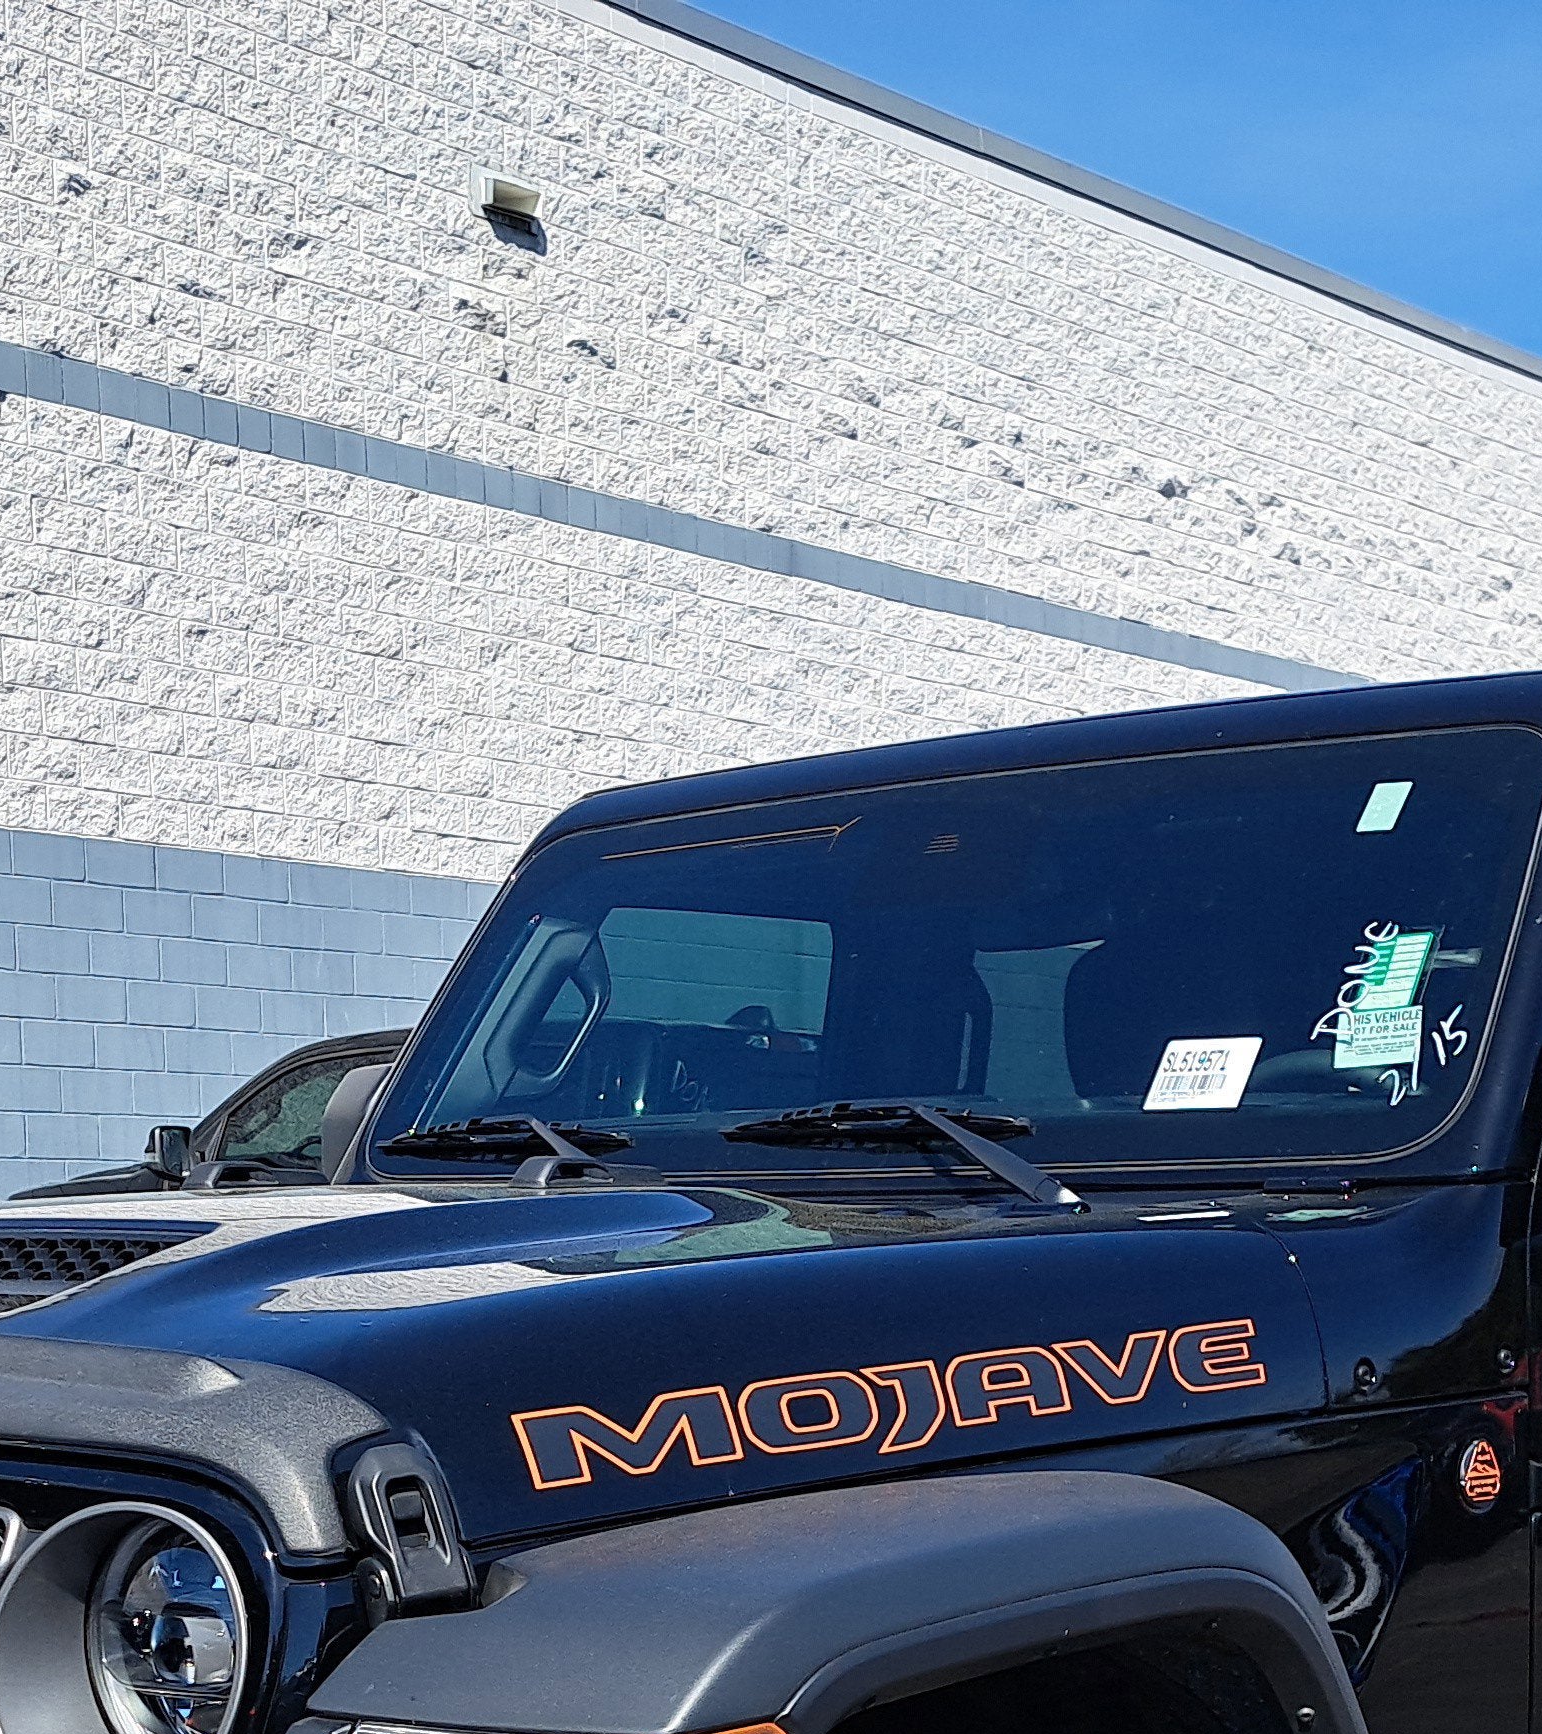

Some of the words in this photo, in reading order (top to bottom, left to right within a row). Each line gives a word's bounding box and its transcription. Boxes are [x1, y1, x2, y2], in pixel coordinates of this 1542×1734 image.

[1346, 1012, 1372, 1027] HIS
[1374, 1008, 1422, 1026] VEHICLE
[1369, 1024, 1390, 1035] FOR
[1392, 1021, 1418, 1033] SALE
[1163, 1050, 1230, 1073] SL519571
[510, 1318, 1267, 1491] MOJAVE
